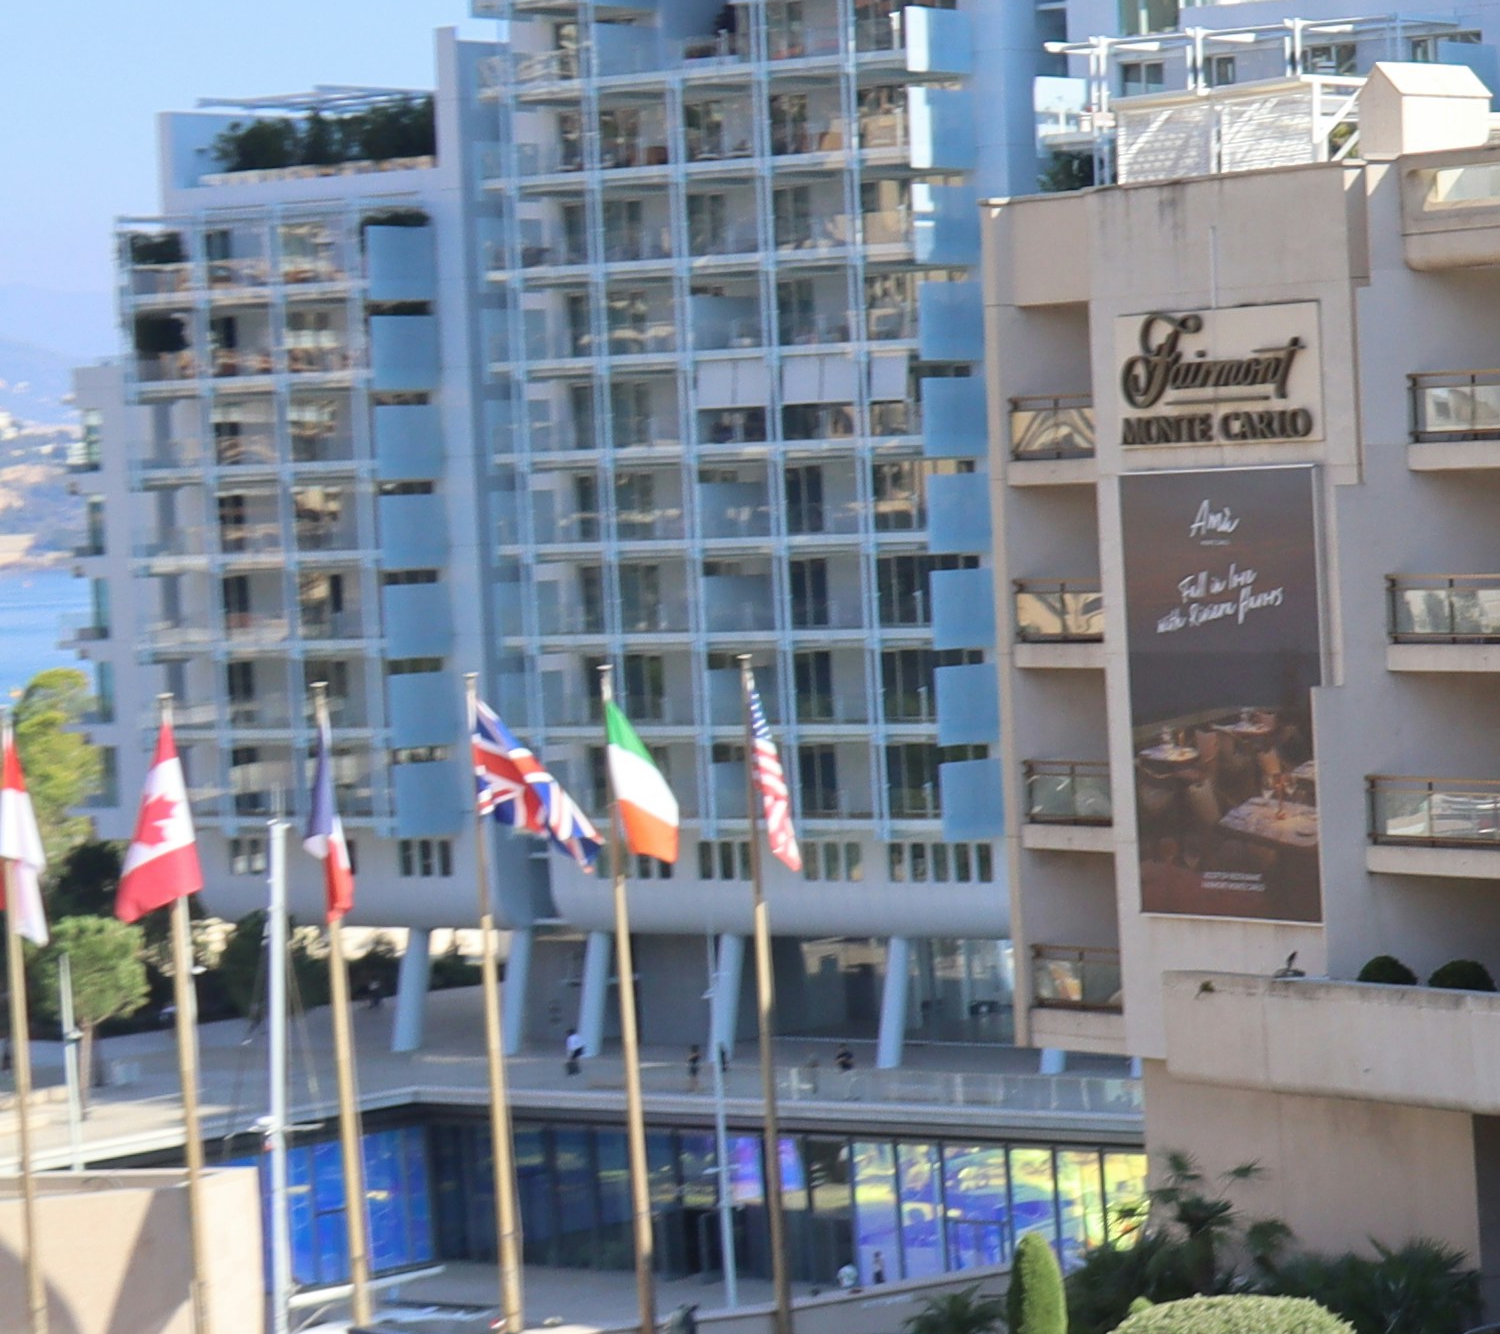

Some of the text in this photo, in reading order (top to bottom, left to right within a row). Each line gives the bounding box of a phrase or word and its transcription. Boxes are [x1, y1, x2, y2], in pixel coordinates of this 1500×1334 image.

[1121, 312, 1307, 409] Fairmont
[1120, 408, 1314, 446] MONTE CARLO
